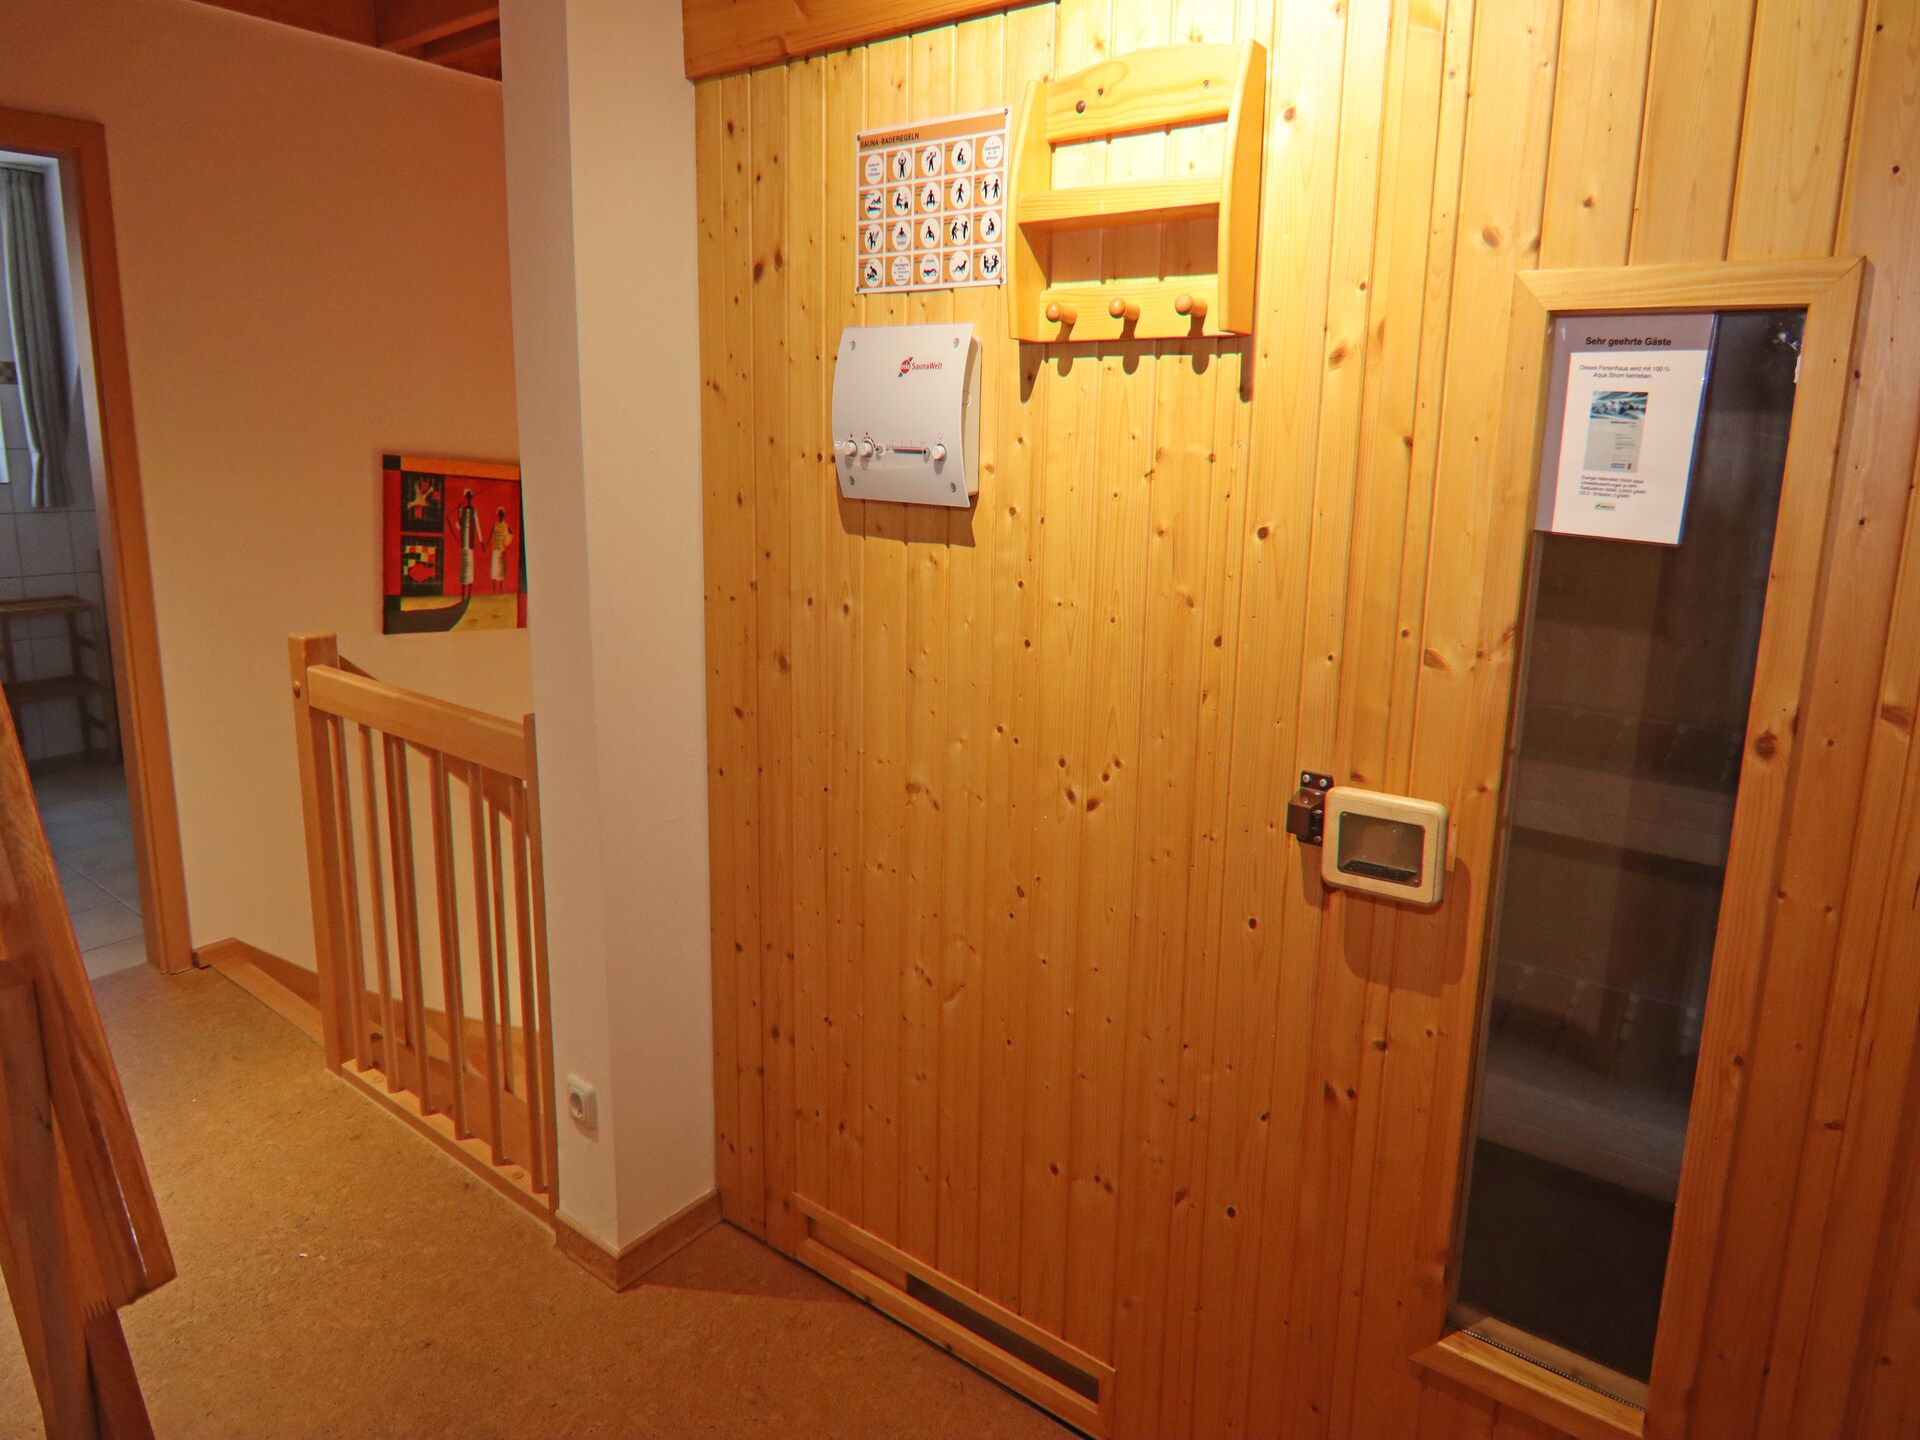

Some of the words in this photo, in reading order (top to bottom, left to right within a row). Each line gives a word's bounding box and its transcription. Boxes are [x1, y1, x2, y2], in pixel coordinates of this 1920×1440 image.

[1585, 337, 1606, 346] Sehr
[1608, 337, 1642, 347] geehrte
[1645, 337, 1672, 346] Gäste
[911, 362, 943, 371] SaunaWelt
